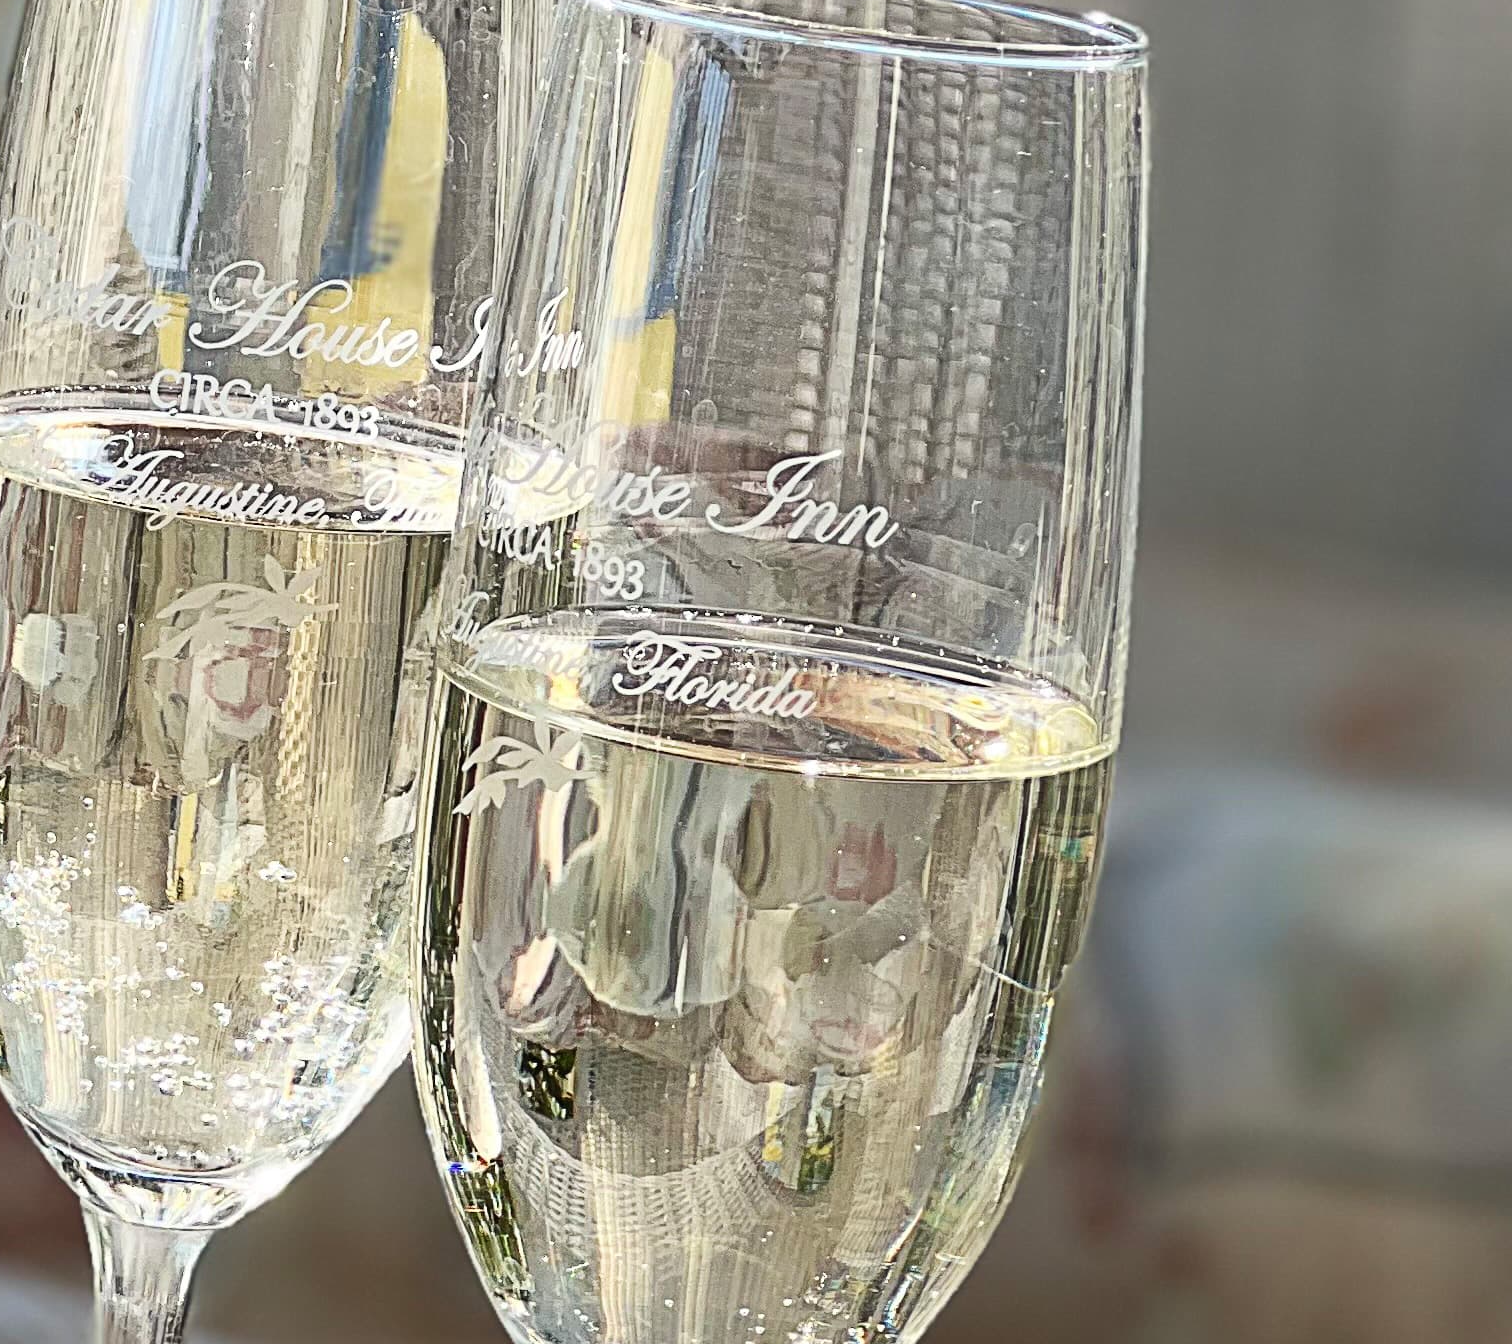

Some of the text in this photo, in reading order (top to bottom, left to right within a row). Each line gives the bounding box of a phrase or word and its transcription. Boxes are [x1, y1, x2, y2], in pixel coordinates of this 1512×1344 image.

[188, 259, 420, 369] House
[150, 368, 380, 441] CIRCA 1893
[706, 449, 900, 549] Inn
[572, 541, 646, 601] 1893
[612, 629, 819, 719] Florida
